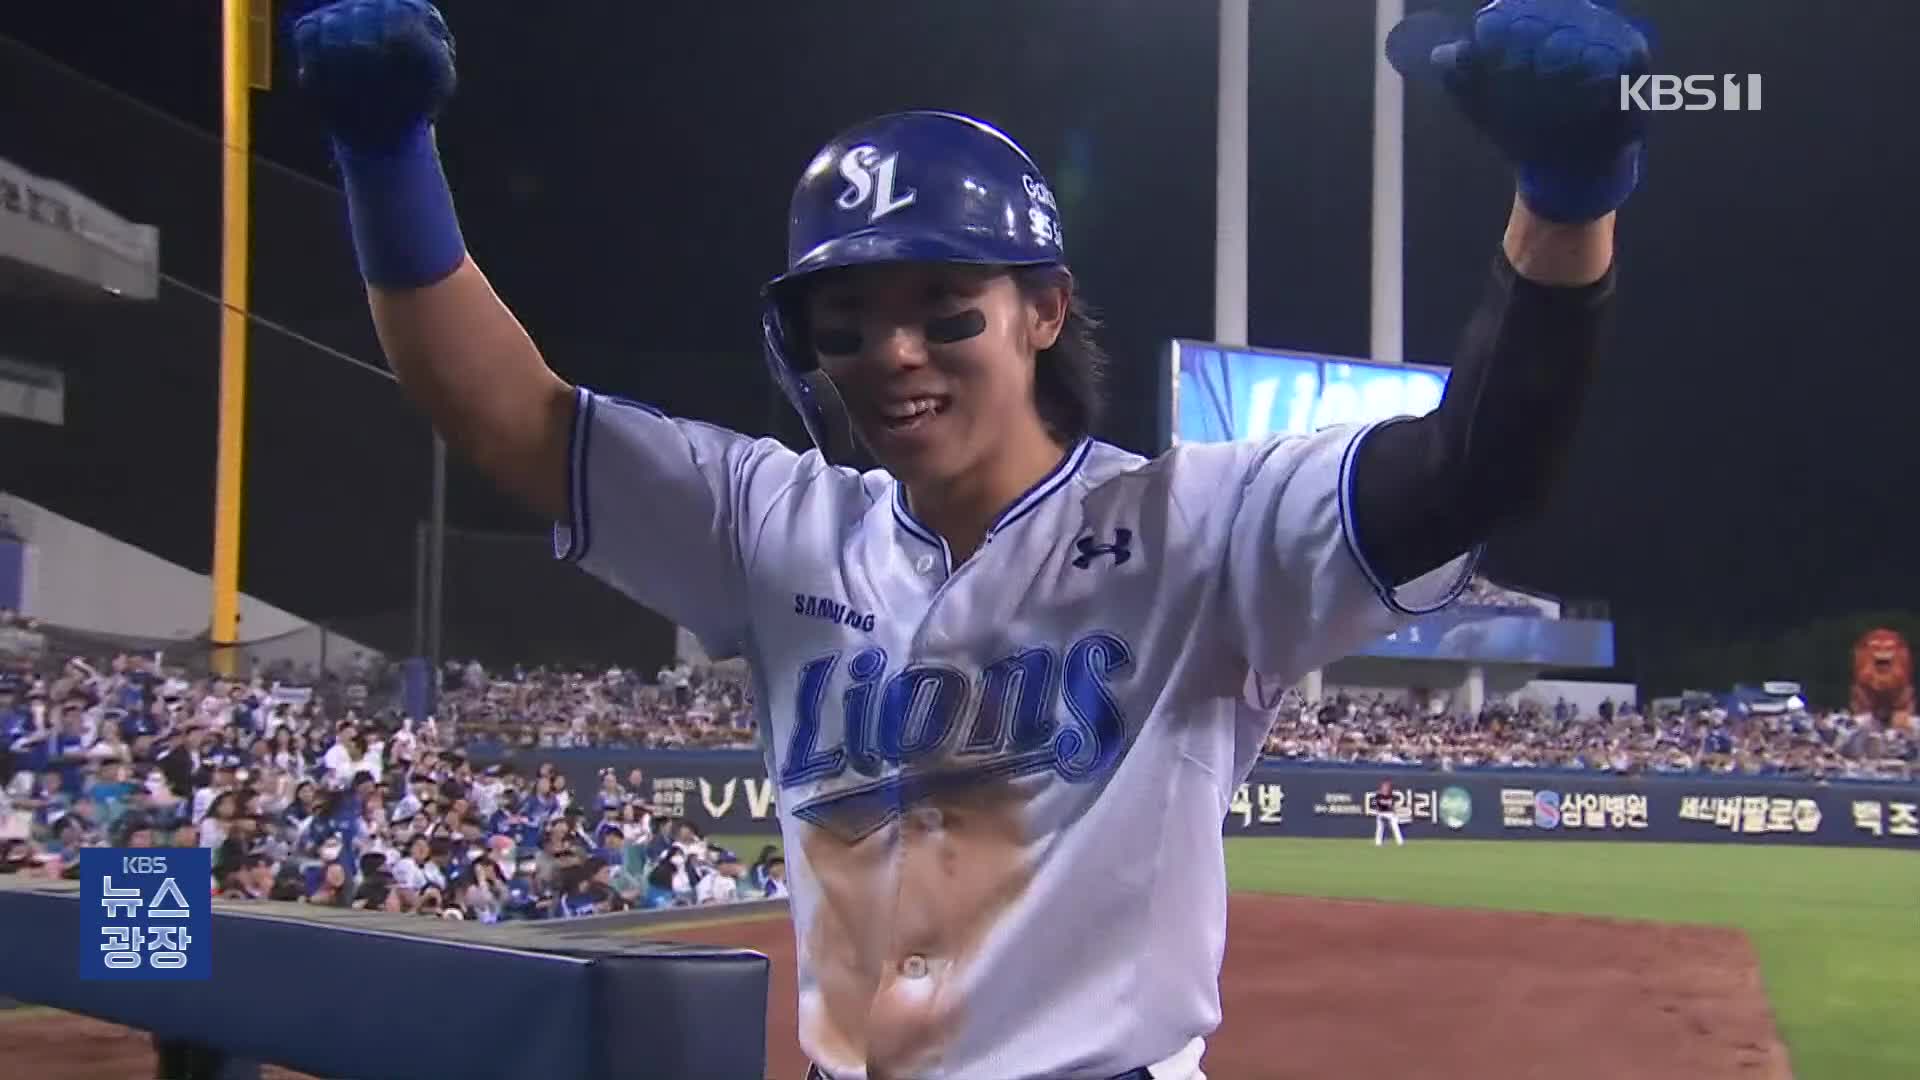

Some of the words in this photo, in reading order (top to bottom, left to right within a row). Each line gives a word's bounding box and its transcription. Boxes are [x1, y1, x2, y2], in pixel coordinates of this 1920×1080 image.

[835, 144, 917, 224] SL
[780, 631, 1134, 788] Lions
[1560, 792, 1649, 829] 삼일병원
